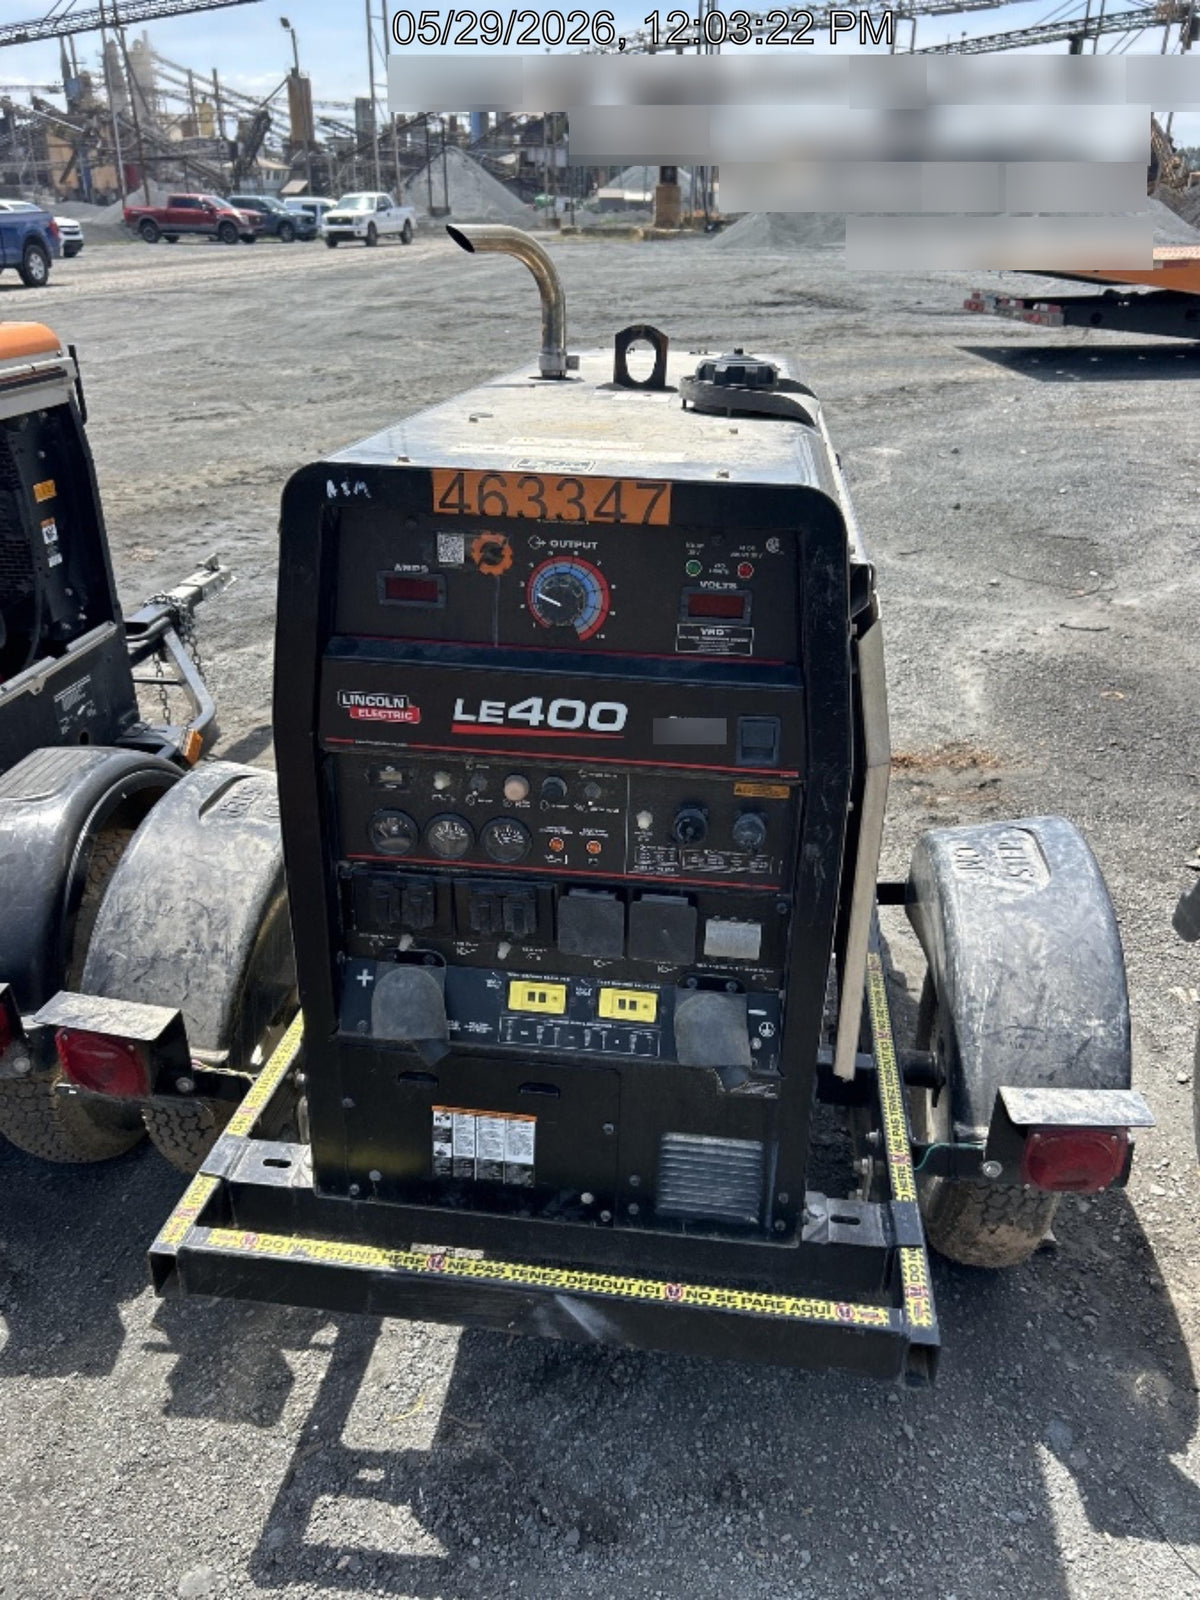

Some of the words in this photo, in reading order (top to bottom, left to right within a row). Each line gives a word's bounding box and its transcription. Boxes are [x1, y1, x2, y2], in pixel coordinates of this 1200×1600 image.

[438, 472, 668, 525] 463347
[549, 540, 598, 551] OUTPUT
[341, 692, 405, 708] LINCOLN
[357, 708, 413, 721] ELECTRIC
[453, 697, 628, 732] LE400
[260, 1238, 285, 1250] DO
[286, 1241, 321, 1255] NOT
[322, 1246, 379, 1261] STAND
[447, 1260, 472, 1273] NE
[474, 1262, 507, 1276] PAS
[510, 1266, 563, 1283] TENEZ
[565, 1272, 635, 1293] DEBOUT
[637, 1283, 661, 1297] ICI
[686, 1289, 712, 1301] NO
[715, 1291, 737, 1305] SE
[741, 1295, 786, 1312] PARE
